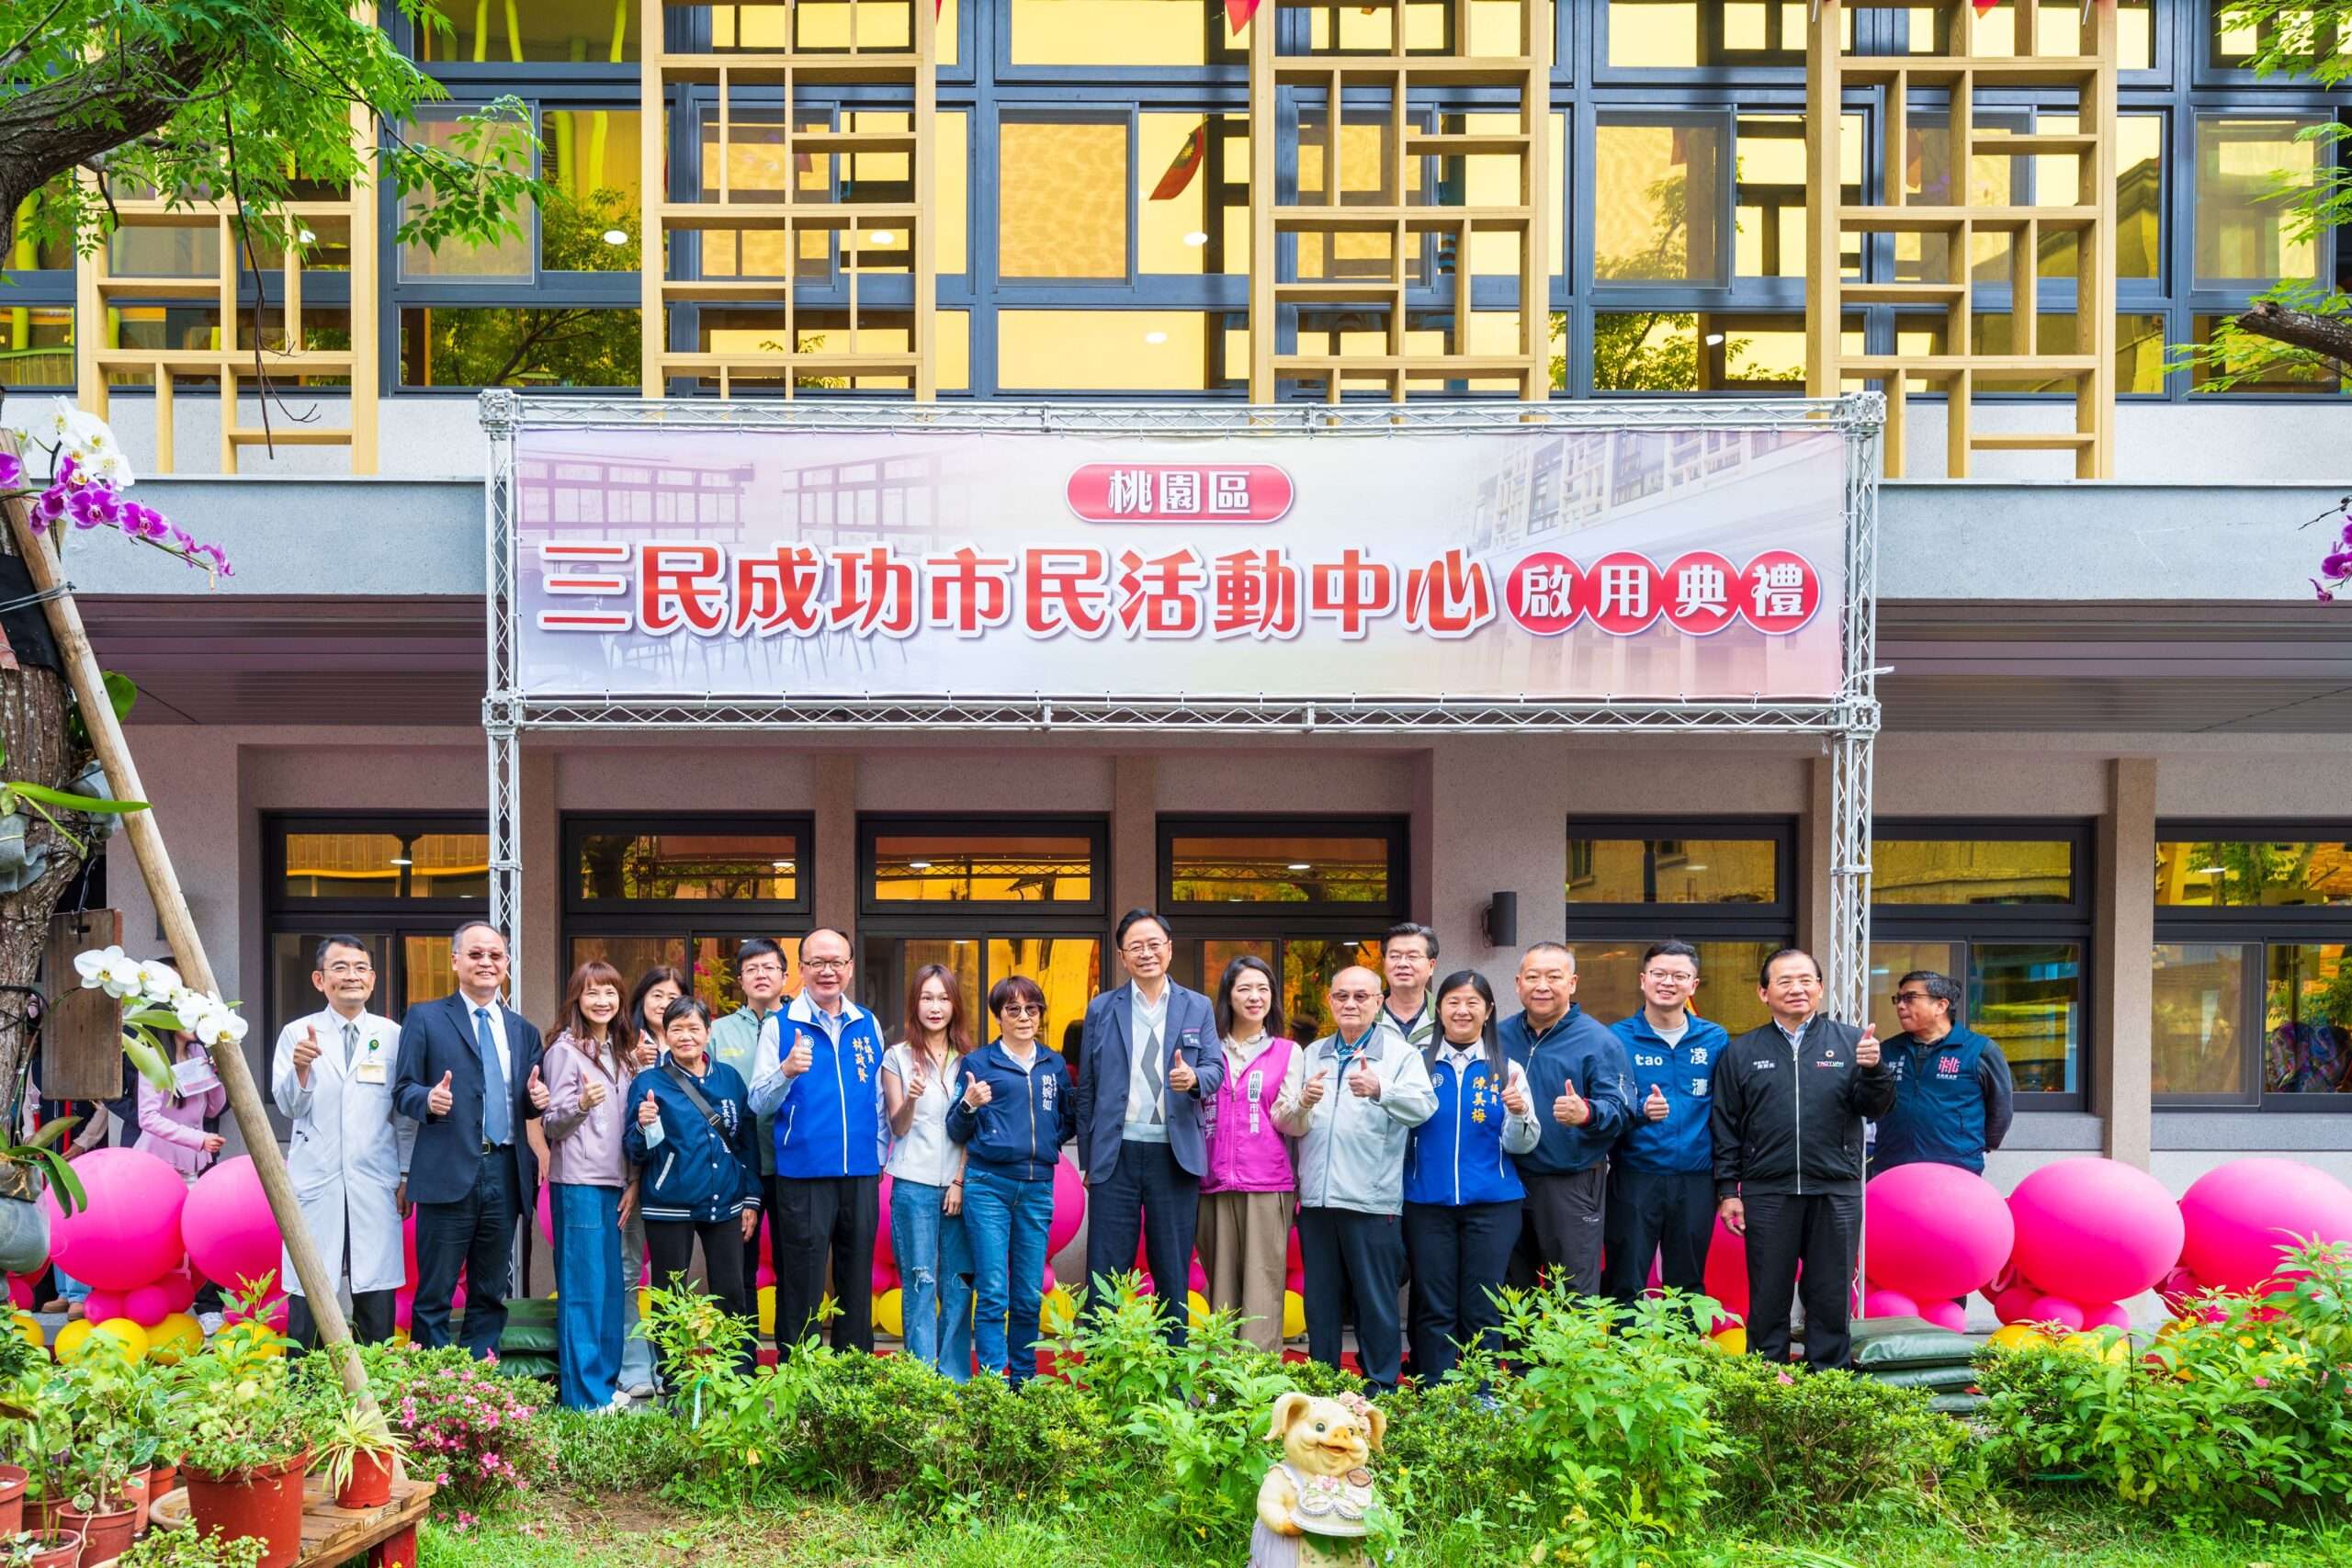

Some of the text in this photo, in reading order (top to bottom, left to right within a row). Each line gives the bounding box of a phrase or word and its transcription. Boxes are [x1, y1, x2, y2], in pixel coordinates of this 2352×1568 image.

[1108, 470, 1250, 513] 桃園區
[538, 540, 1806, 638] 三民成功市民活動中心 啟用典禮
[1634, 1053, 1664, 1066] tao
